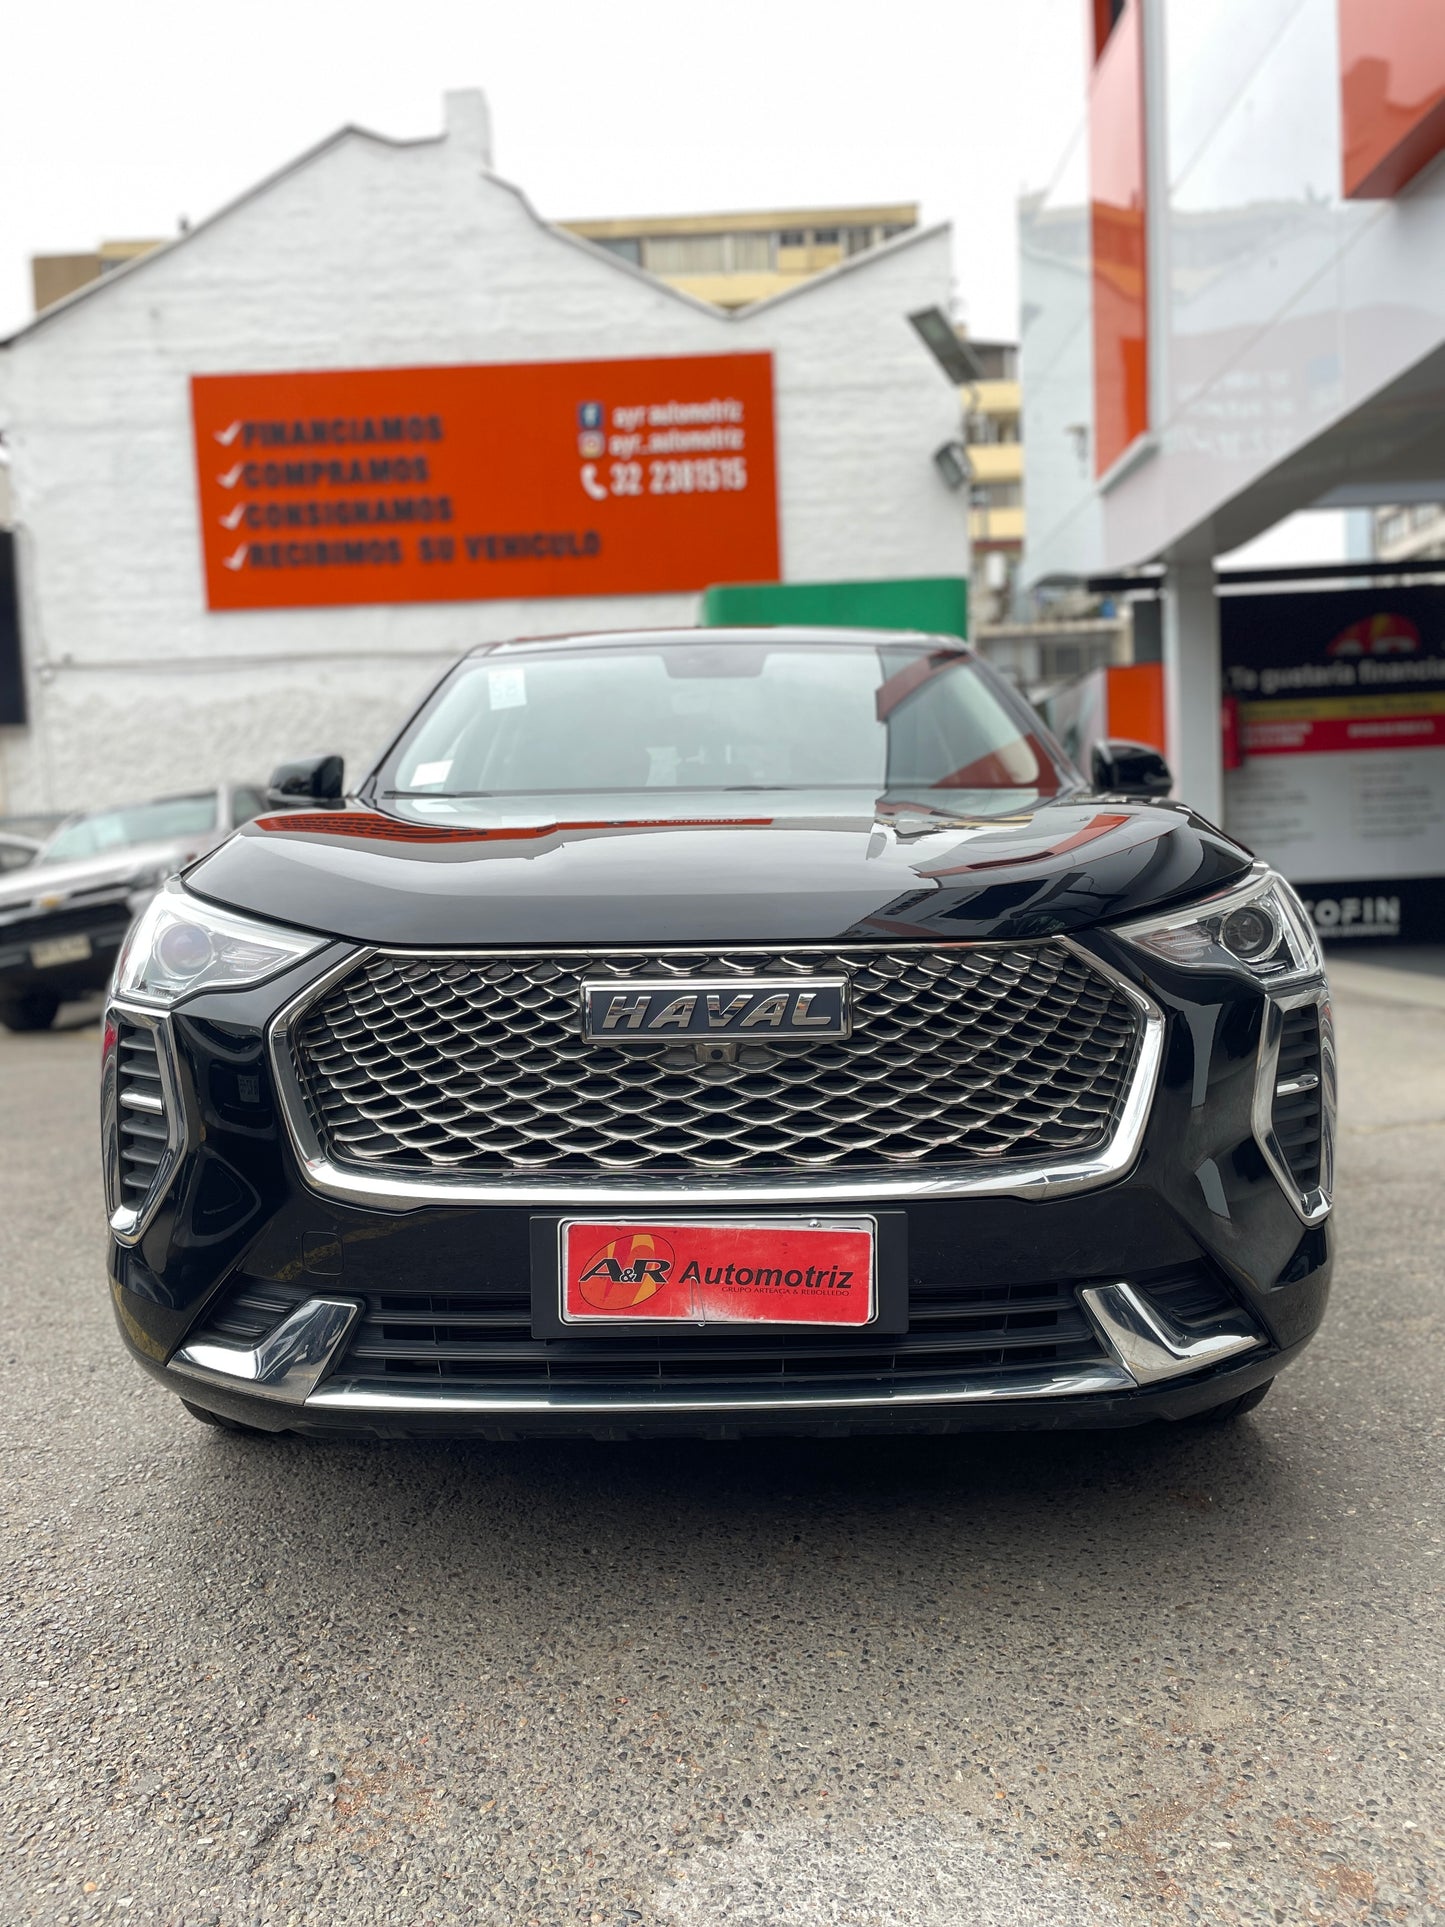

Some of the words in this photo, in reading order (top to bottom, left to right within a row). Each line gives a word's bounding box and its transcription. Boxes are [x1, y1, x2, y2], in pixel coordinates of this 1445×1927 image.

[243, 416, 443, 446] FINANCIAMOS
[243, 457, 429, 488] COMPRAMOS
[610, 462, 642, 495] 32
[244, 497, 453, 528] CONSIGNAMOS
[248, 539, 402, 567] RECIBIMOS
[419, 537, 454, 562] SU
[466, 531, 600, 560] VEHICULO
[602, 993, 831, 1028] HAVAL
[579, 1258, 672, 1284] A&R
[679, 1261, 853, 1288] Automotriz
[722, 1286, 751, 1294] GRUPO
[754, 1287, 790, 1295] ARTEAGA
